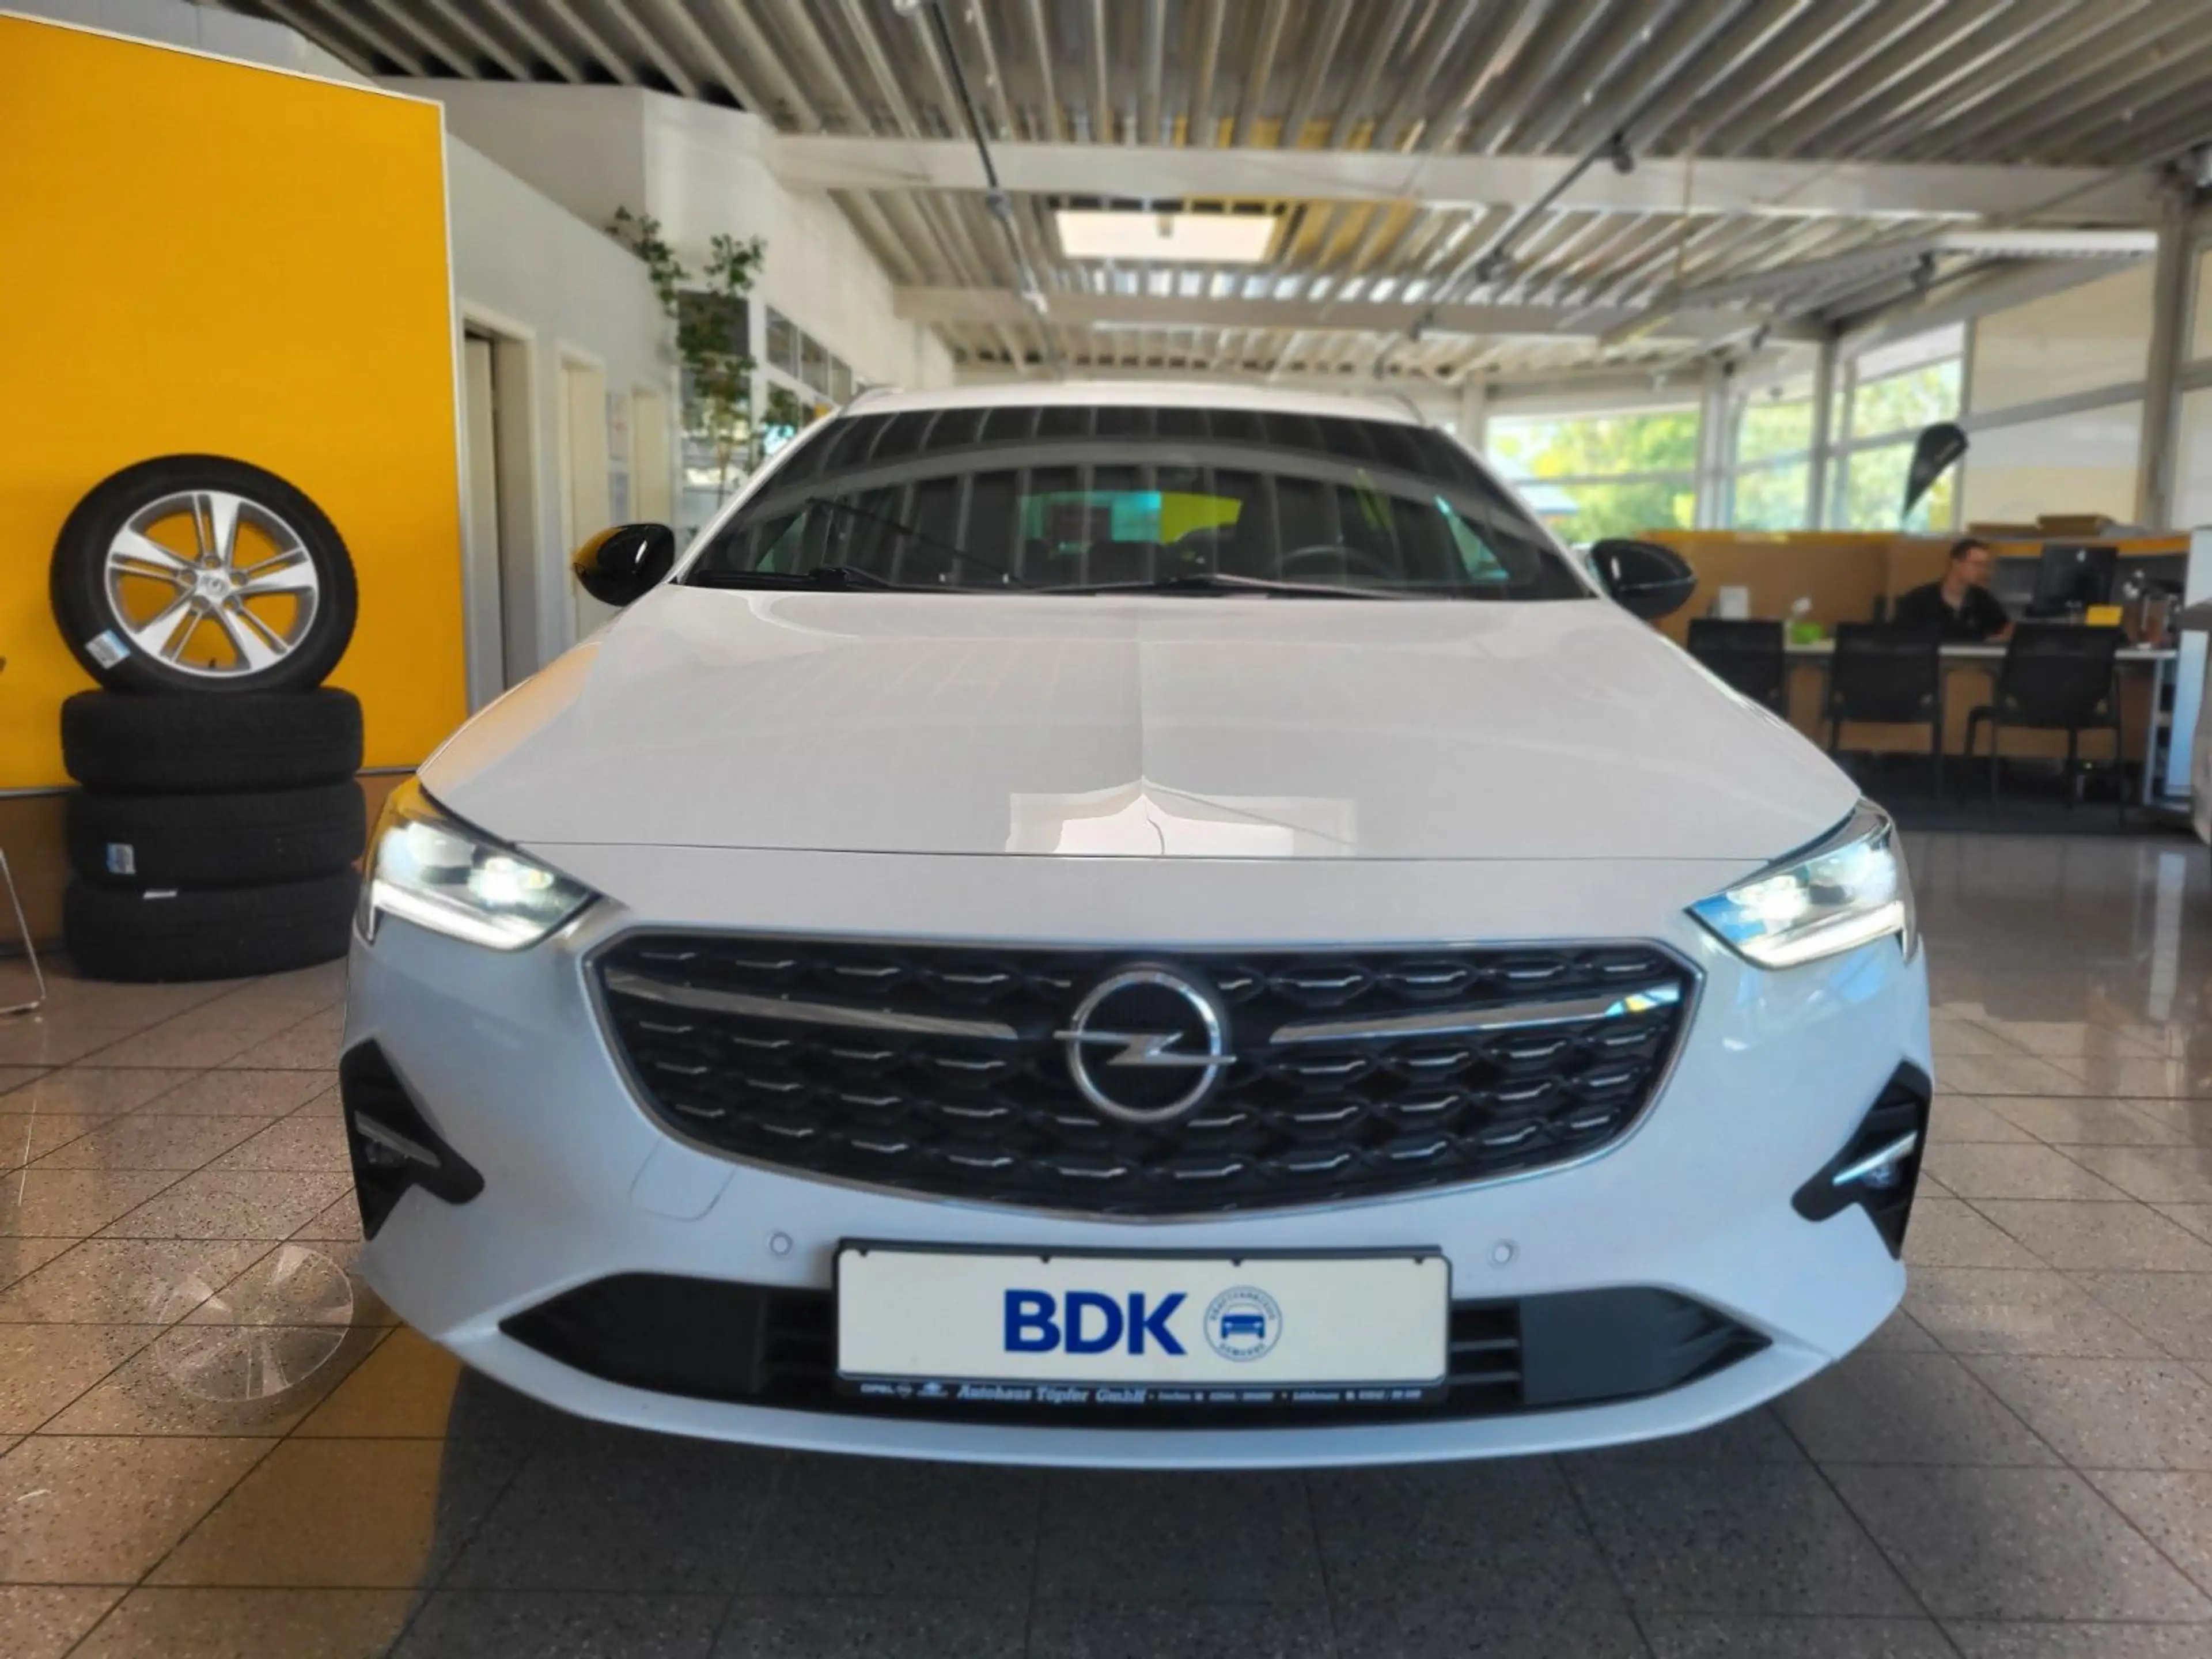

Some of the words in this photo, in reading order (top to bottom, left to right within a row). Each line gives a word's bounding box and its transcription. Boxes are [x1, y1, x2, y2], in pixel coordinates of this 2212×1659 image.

[1004, 1289, 1187, 1355] BDK
[957, 1384, 1032, 1400] Autohaus
[1096, 1387, 1146, 1403] GmbH
